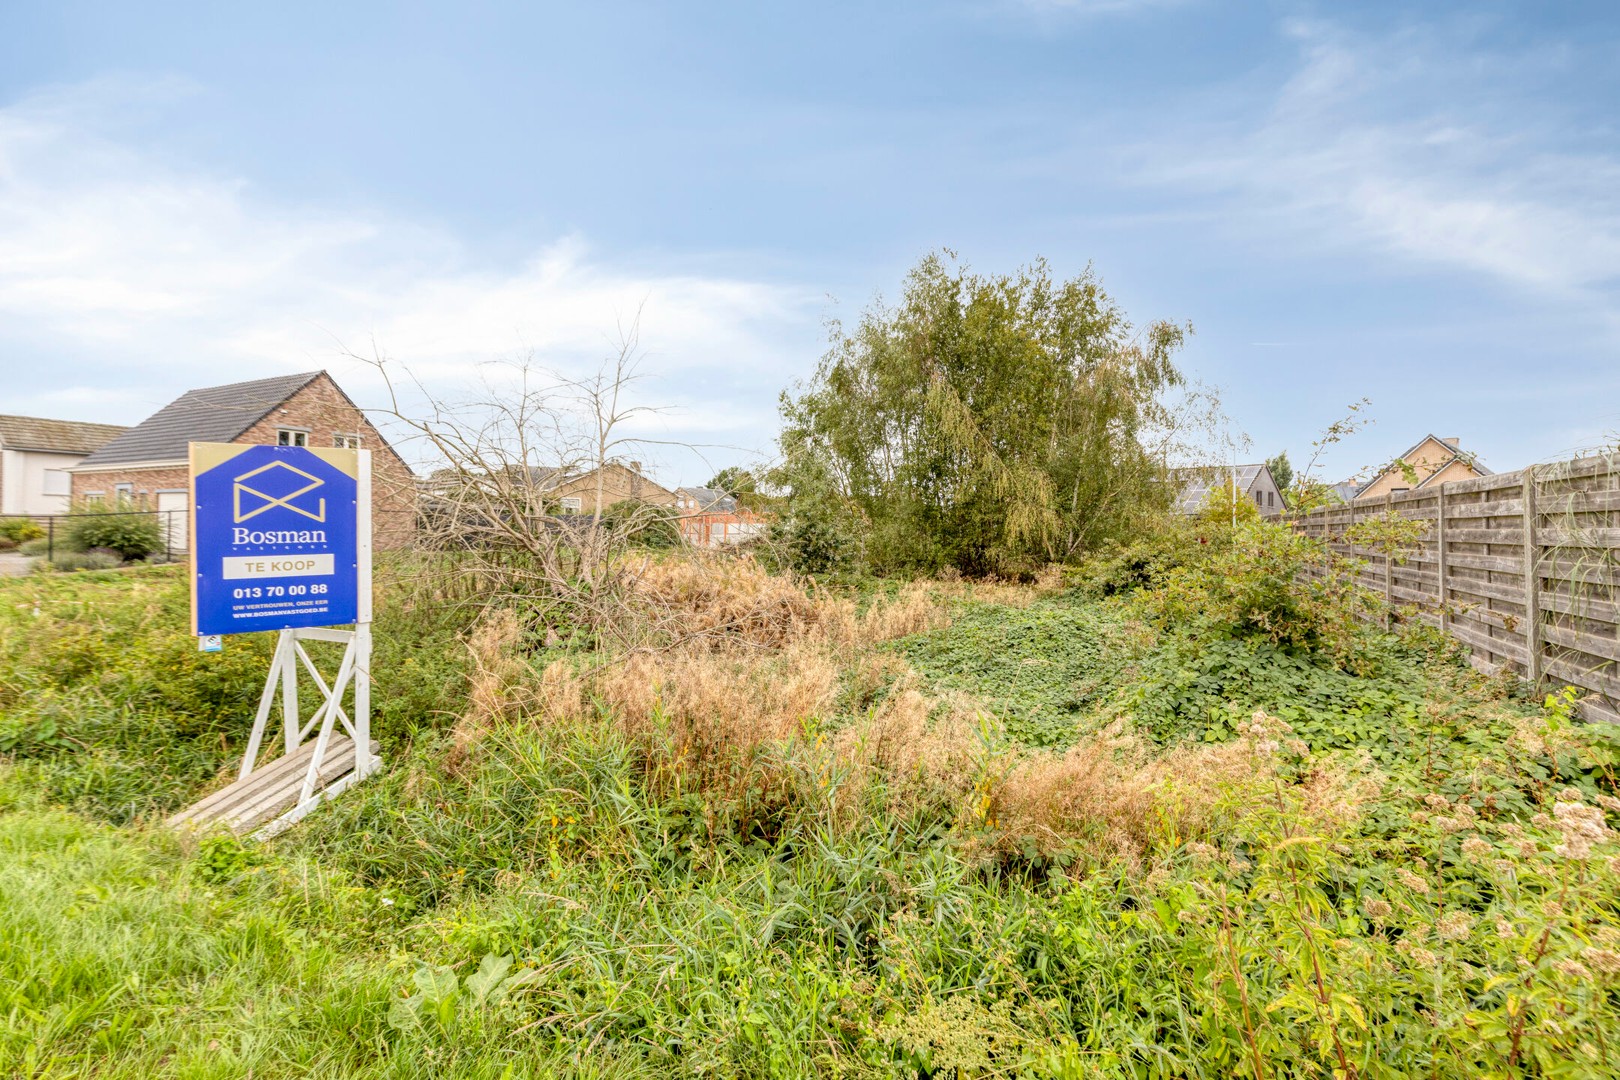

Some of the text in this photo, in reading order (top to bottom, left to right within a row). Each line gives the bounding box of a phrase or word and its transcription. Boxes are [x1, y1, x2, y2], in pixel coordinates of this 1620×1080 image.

[232, 527, 327, 545] Bosman
[245, 560, 315, 572] TE KOOP
[233, 584, 328, 599] 013 70 00 88
[232, 607, 329, 619] WWW.BOSMANVASTGOED.BE
